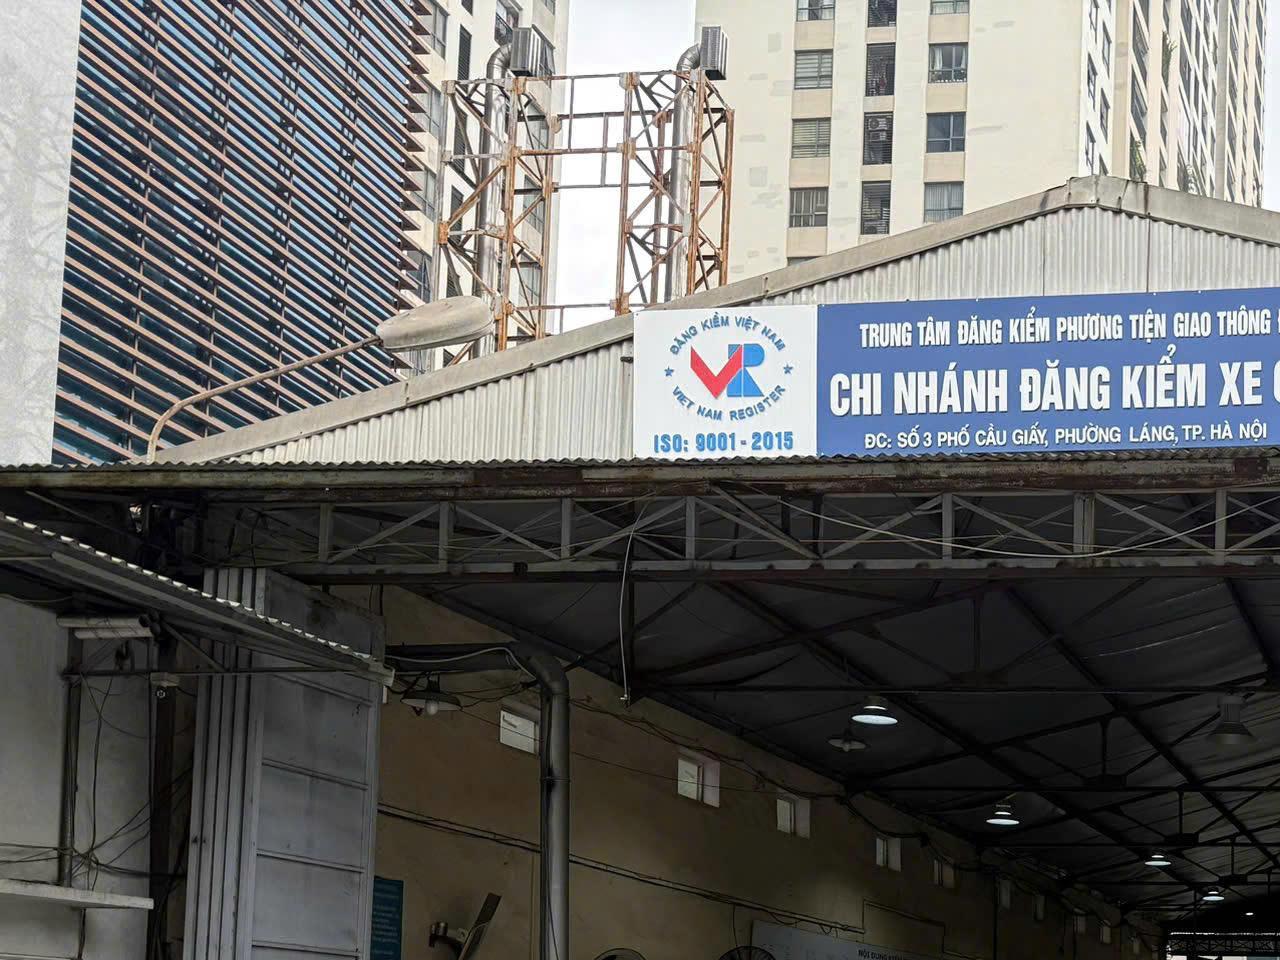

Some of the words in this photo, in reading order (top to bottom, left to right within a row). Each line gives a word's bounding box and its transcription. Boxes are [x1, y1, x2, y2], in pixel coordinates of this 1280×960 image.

[669, 325, 698, 355] ĐĂNG
[734, 316, 761, 331] VIỆT
[761, 326, 786, 352] NAM
[860, 321, 912, 348] TRUNG
[917, 316, 950, 346] TÂM
[958, 315, 1002, 345] ĐĂNG
[1009, 306, 1050, 343] KIỂM
[1056, 313, 1123, 342] PHƯƠNG
[1130, 308, 1167, 343] TIỆN
[1173, 312, 1211, 338] GIAO
[1217, 304, 1271, 336] THÔNG
[830, 372, 882, 416] CHI
[894, 362, 1008, 415] NHÁNH
[1020, 359, 1111, 412] ĐĂNG
[1122, 344, 1206, 409] KIỂM
[1219, 361, 1263, 407] XE
[672, 385, 696, 410] VIET
[697, 405, 723, 420] NAM
[729, 384, 786, 421] REGISTER
[653, 433, 689, 453] ISO:
[864, 432, 892, 449] ĐC:
[897, 424, 920, 447] SỐ
[923, 431, 932, 447] 3
[937, 424, 970, 447] PHỐ
[975, 423, 1007, 446] CẦU
[1012, 422, 1048, 447] GIẤY,
[1055, 422, 1121, 444] PHƯỜNG
[1129, 422, 1179, 447] LÁNG,
[1182, 424, 1206, 441] TP.
[1210, 420, 1233, 440] HÀ
[1239, 419, 1267, 442] NỘI
